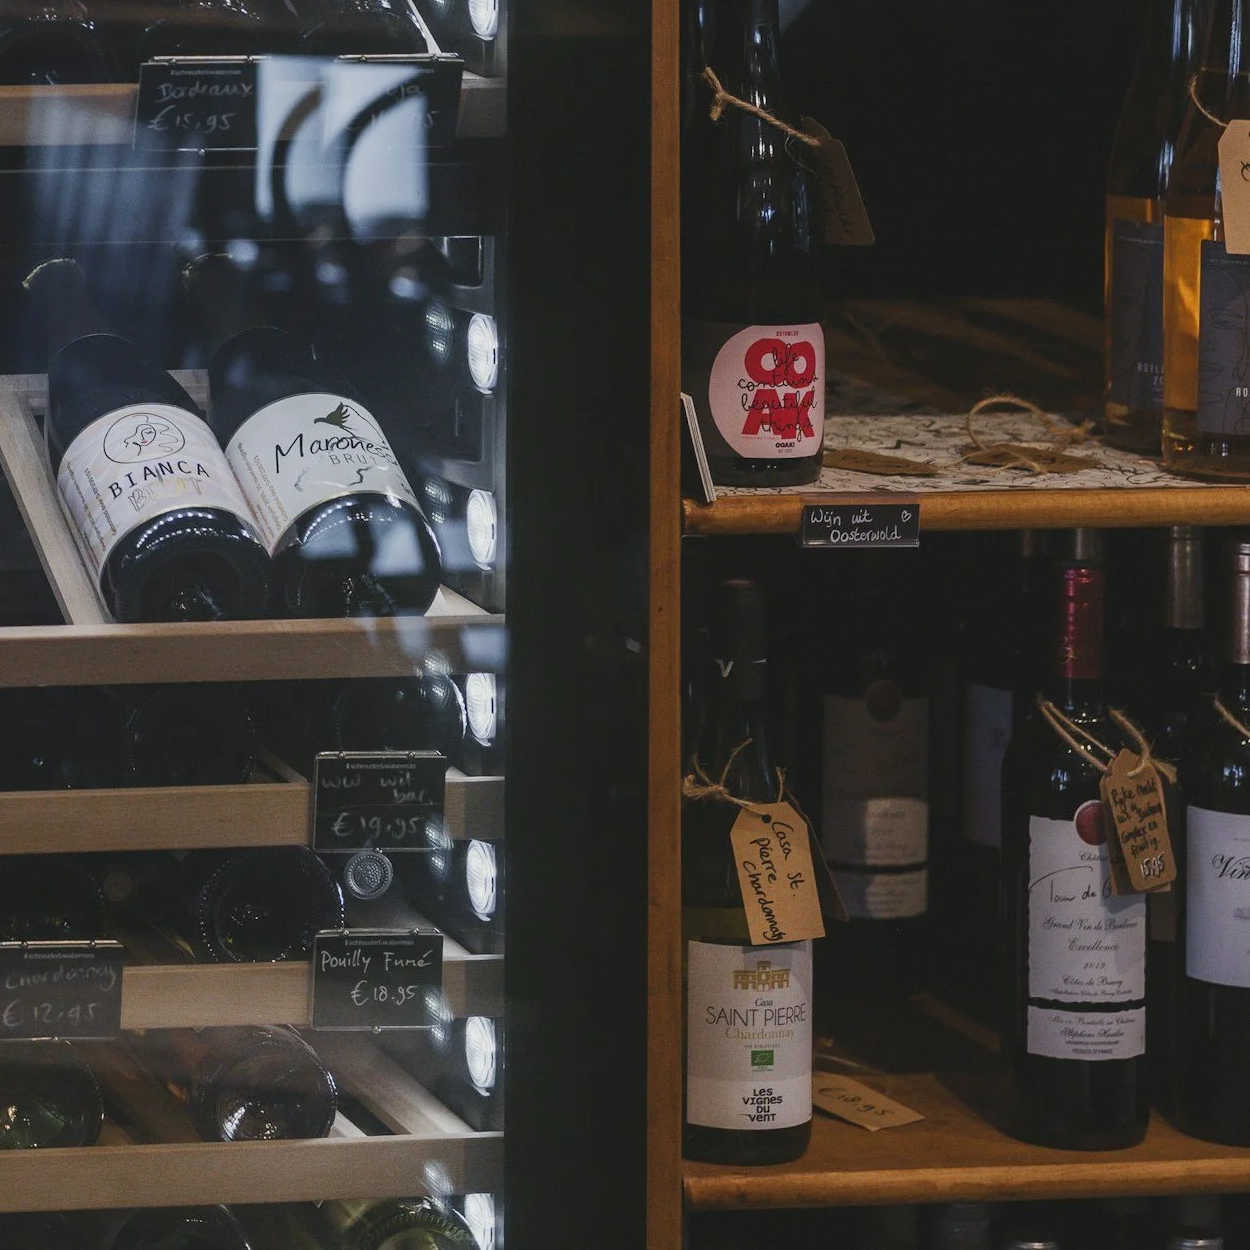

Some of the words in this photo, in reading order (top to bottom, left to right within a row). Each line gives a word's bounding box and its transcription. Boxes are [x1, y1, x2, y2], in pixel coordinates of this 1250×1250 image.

[108, 460, 210, 499] BIANCA
[811, 507, 842, 529] Wijn
[830, 525, 902, 543] Oosterwold
[331, 812, 355, 837] €
[1082, 884, 1098, 901] de
[319, 947, 372, 974] Pouilly
[349, 979, 372, 1006] €
[754, 997, 775, 1008] Casa
[0, 998, 23, 1027] €
[705, 1006, 759, 1029] SAINT
[764, 1002, 807, 1029] PIERRE
